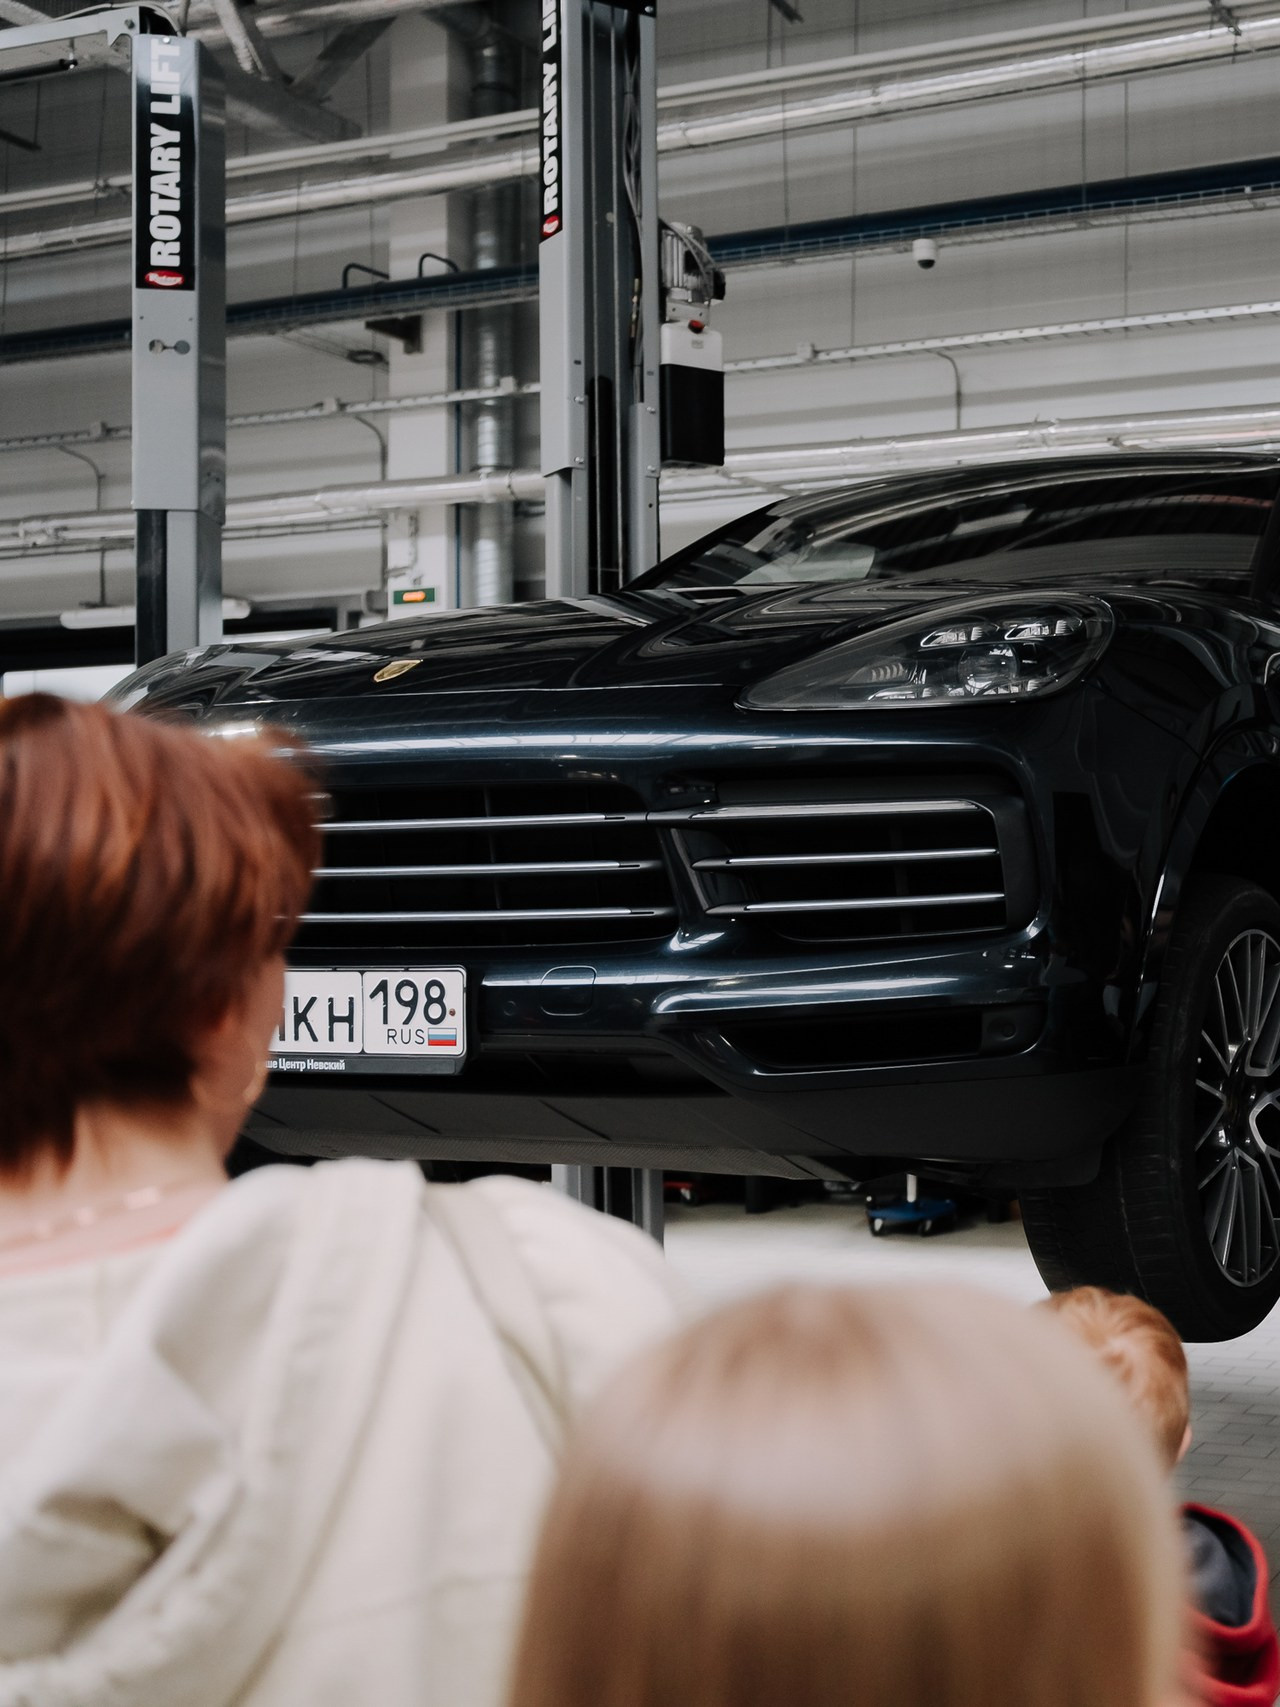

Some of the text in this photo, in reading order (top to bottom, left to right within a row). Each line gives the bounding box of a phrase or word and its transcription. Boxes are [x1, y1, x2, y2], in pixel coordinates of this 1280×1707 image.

[149, 38, 181, 267] ROTARY LIFT
[543, 62, 558, 215] ROTARY
[369, 979, 447, 1025] 198
[387, 1029, 425, 1045] RUS
[279, 1058, 306, 1072] Центр
[307, 1058, 346, 1071] Невский
